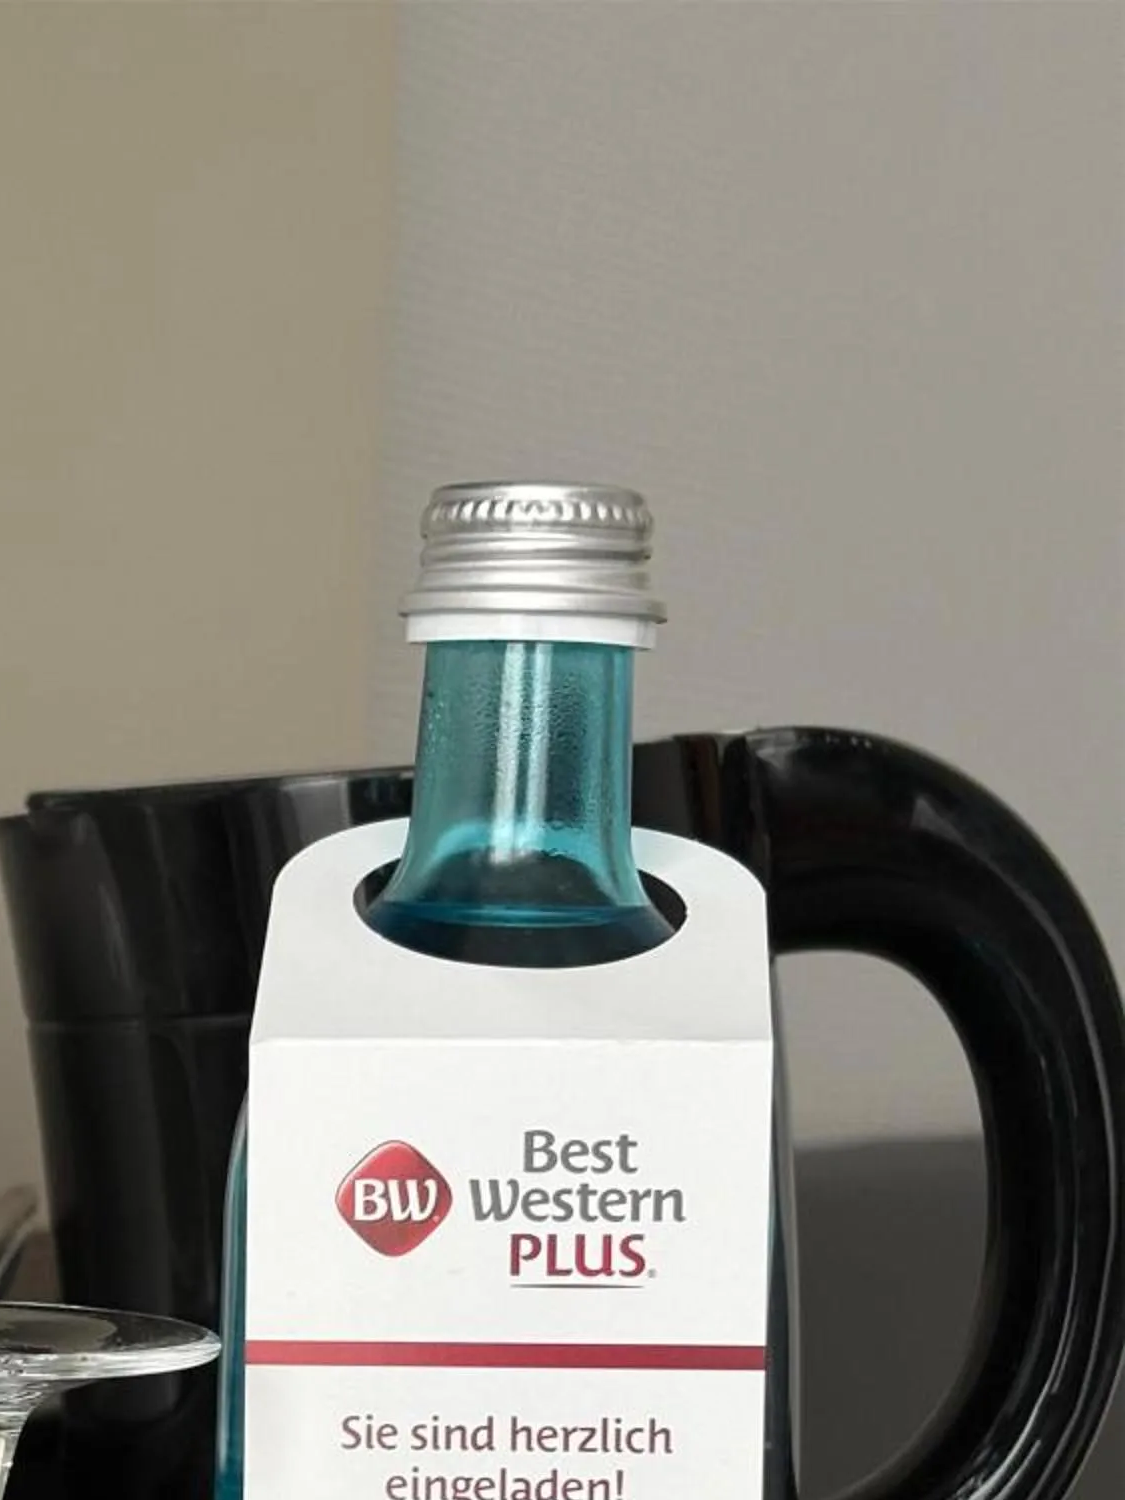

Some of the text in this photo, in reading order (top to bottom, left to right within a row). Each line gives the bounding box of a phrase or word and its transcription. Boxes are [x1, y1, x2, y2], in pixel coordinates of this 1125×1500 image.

[522, 1129, 638, 1174] Best
[352, 1178, 438, 1224] BW
[469, 1178, 686, 1223] Western
[509, 1233, 647, 1278] PLUS
[340, 1414, 673, 1454] Sie sind herzlich
